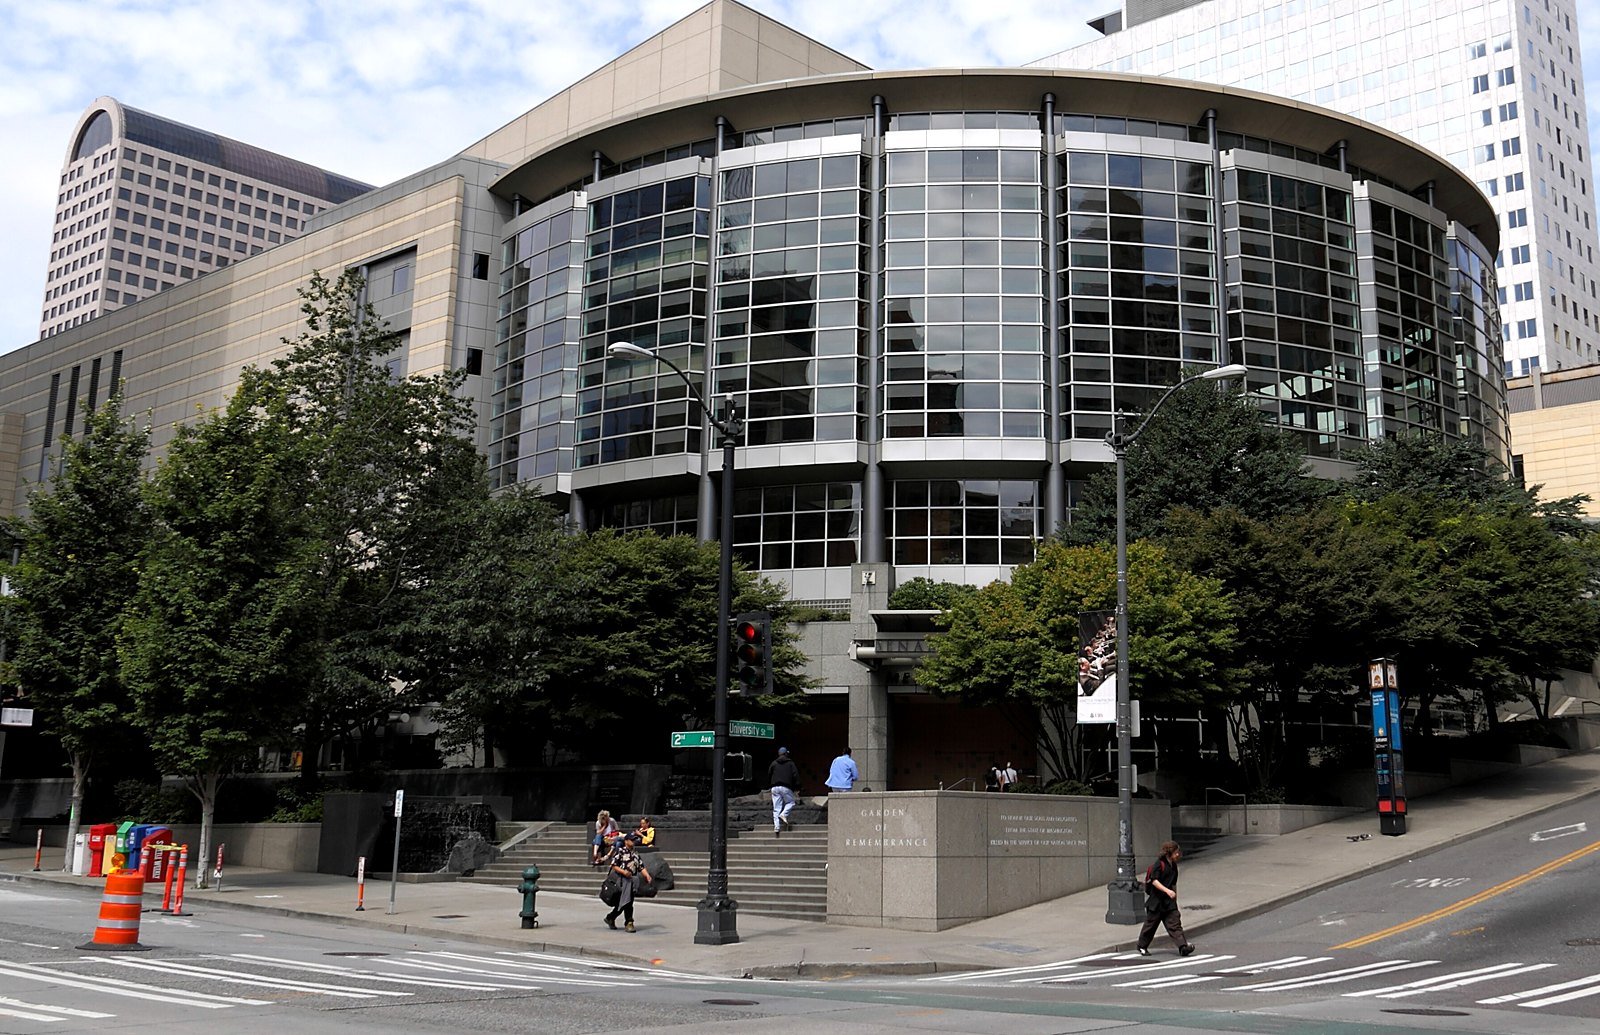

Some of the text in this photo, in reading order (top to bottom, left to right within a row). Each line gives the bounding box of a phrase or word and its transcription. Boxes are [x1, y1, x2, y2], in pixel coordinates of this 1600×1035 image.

[729, 722, 760, 736] University
[760, 727, 766, 736] St
[674, 734, 711, 745] 2nd Ave
[861, 809, 904, 817] GARDEN
[875, 823, 887, 832] OF
[845, 838, 928, 847] REMEMBRANCE
